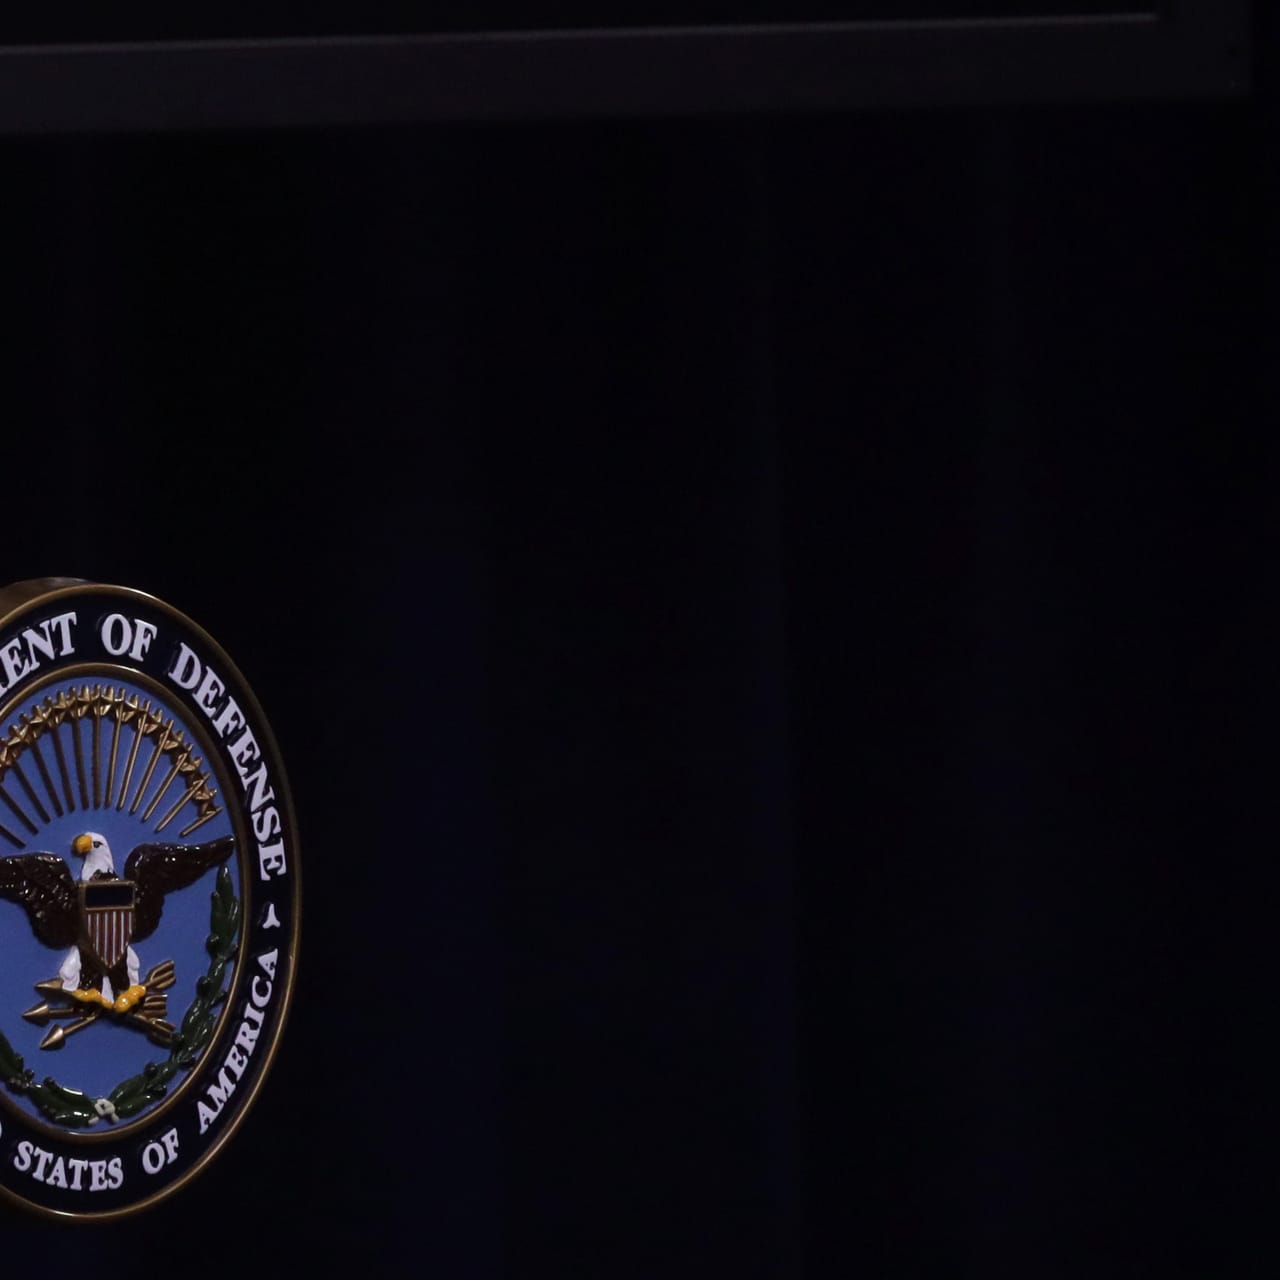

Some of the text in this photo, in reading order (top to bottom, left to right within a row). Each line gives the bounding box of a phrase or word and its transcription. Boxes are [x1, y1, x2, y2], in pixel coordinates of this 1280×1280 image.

[100, 613, 158, 662] OF
[167, 641, 287, 882] DEFENSE
[12, 1140, 124, 1192] STATES
[142, 1127, 179, 1174] OF
[197, 948, 280, 1134] AMERICA
